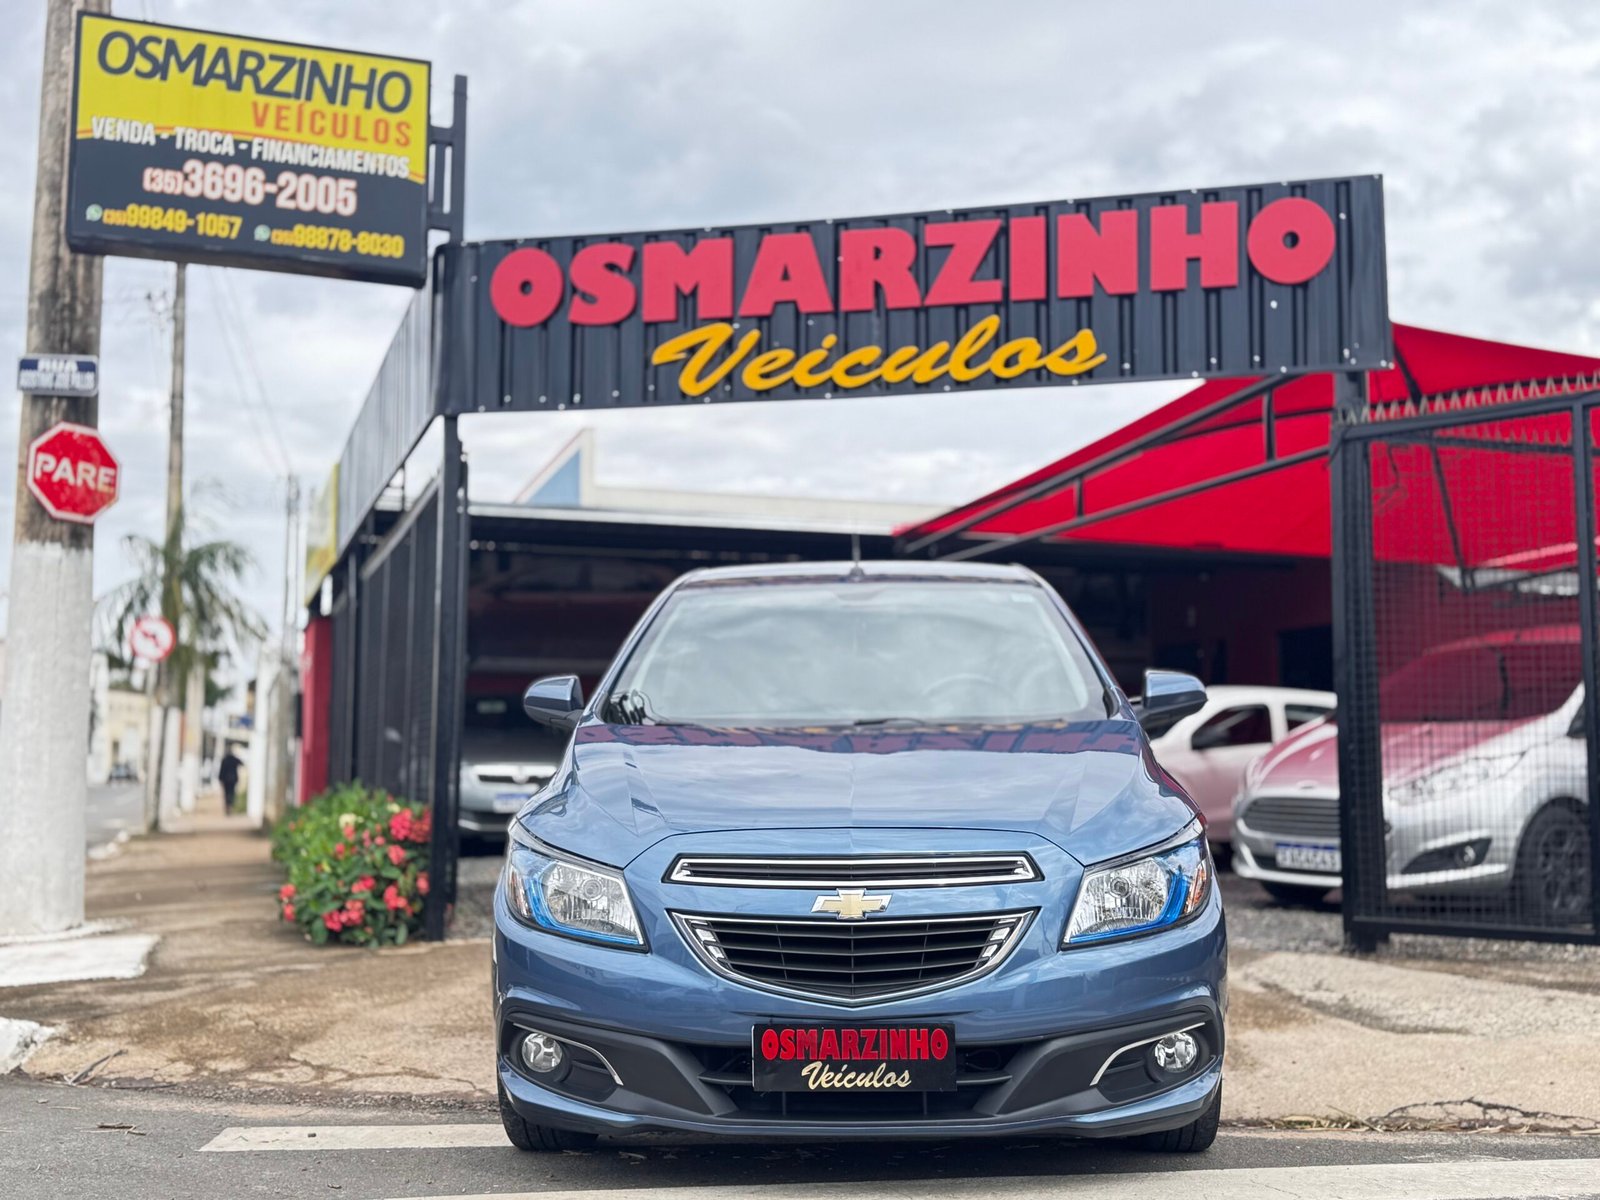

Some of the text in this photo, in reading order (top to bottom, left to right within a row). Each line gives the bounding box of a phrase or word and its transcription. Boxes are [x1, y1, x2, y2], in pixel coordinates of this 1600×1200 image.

[97, 30, 413, 114] OSMARZINHO
[91, 115, 156, 147] VENDA
[174, 126, 235, 157] TROCA
[251, 136, 410, 179] FINANCIAMENTOS
[251, 100, 412, 148] VEÍCULOS
[142, 158, 358, 217] (35)3696-2005
[102, 203, 243, 240] 99849-1057
[271, 223, 405, 259] 98878-8030
[489, 196, 1336, 328] OSMARZINHO
[34, 453, 116, 492] PARE
[761, 1028, 948, 1060] OSMARZINHO
